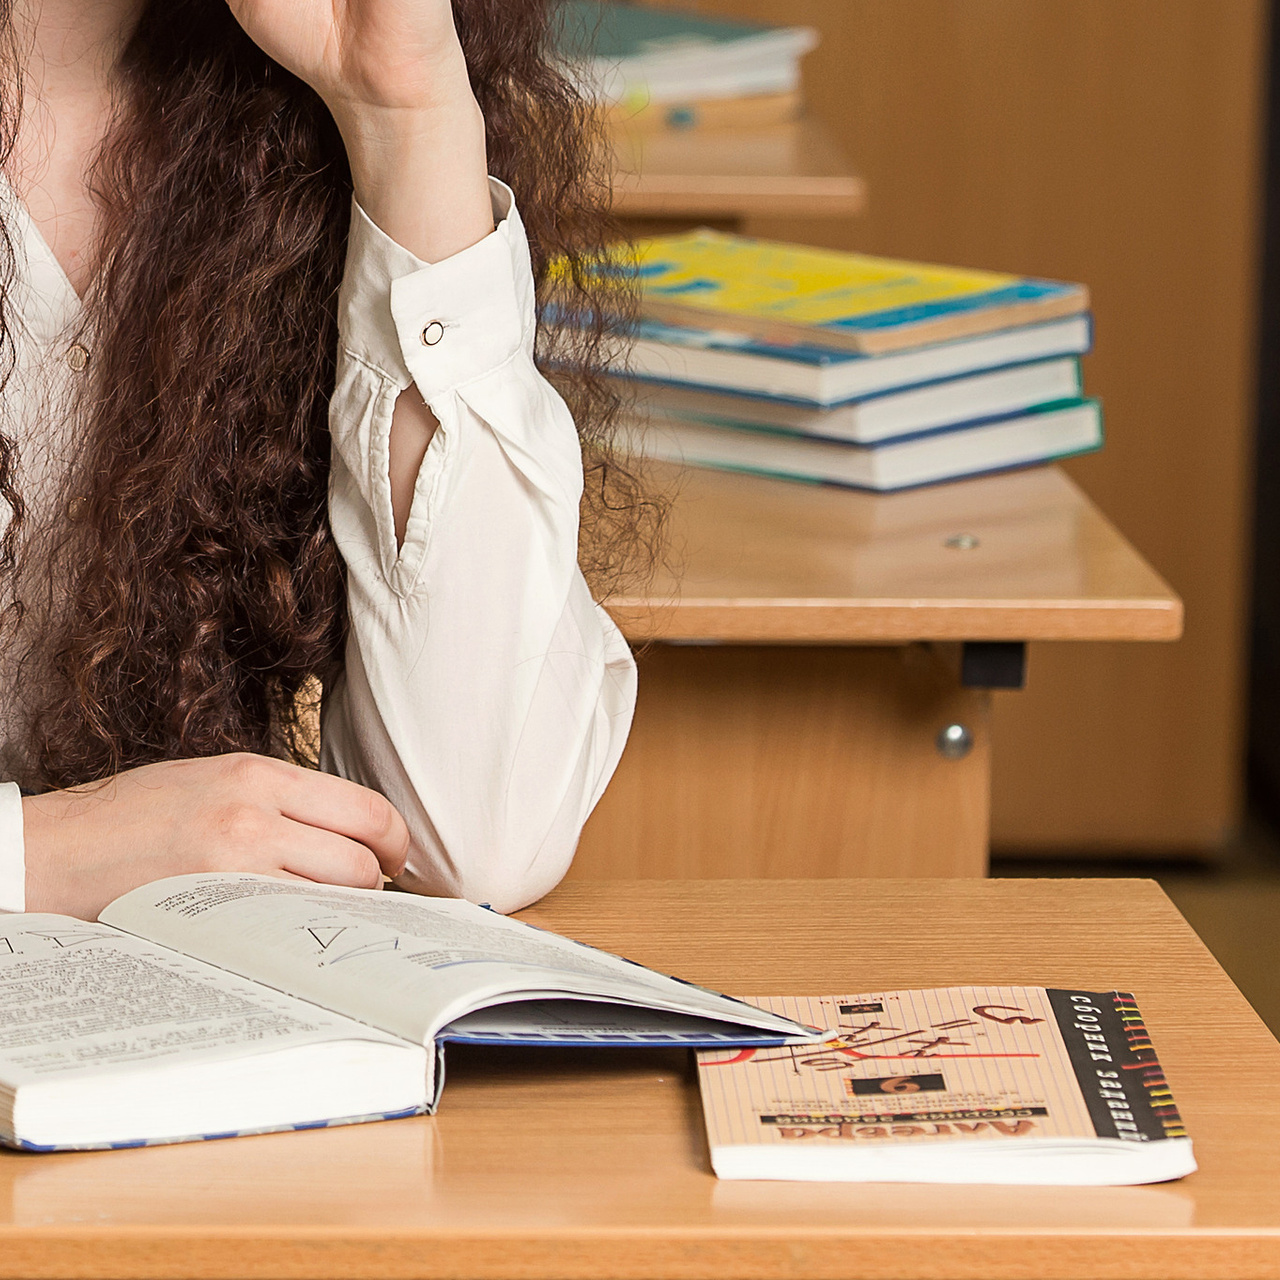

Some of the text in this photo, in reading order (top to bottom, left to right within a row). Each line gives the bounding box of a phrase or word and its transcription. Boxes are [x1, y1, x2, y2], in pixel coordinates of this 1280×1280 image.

[1070, 995, 1150, 1142] сборник заданий
[880, 1076, 921, 1095] 9
[776, 1119, 1038, 1143] Алгебра
